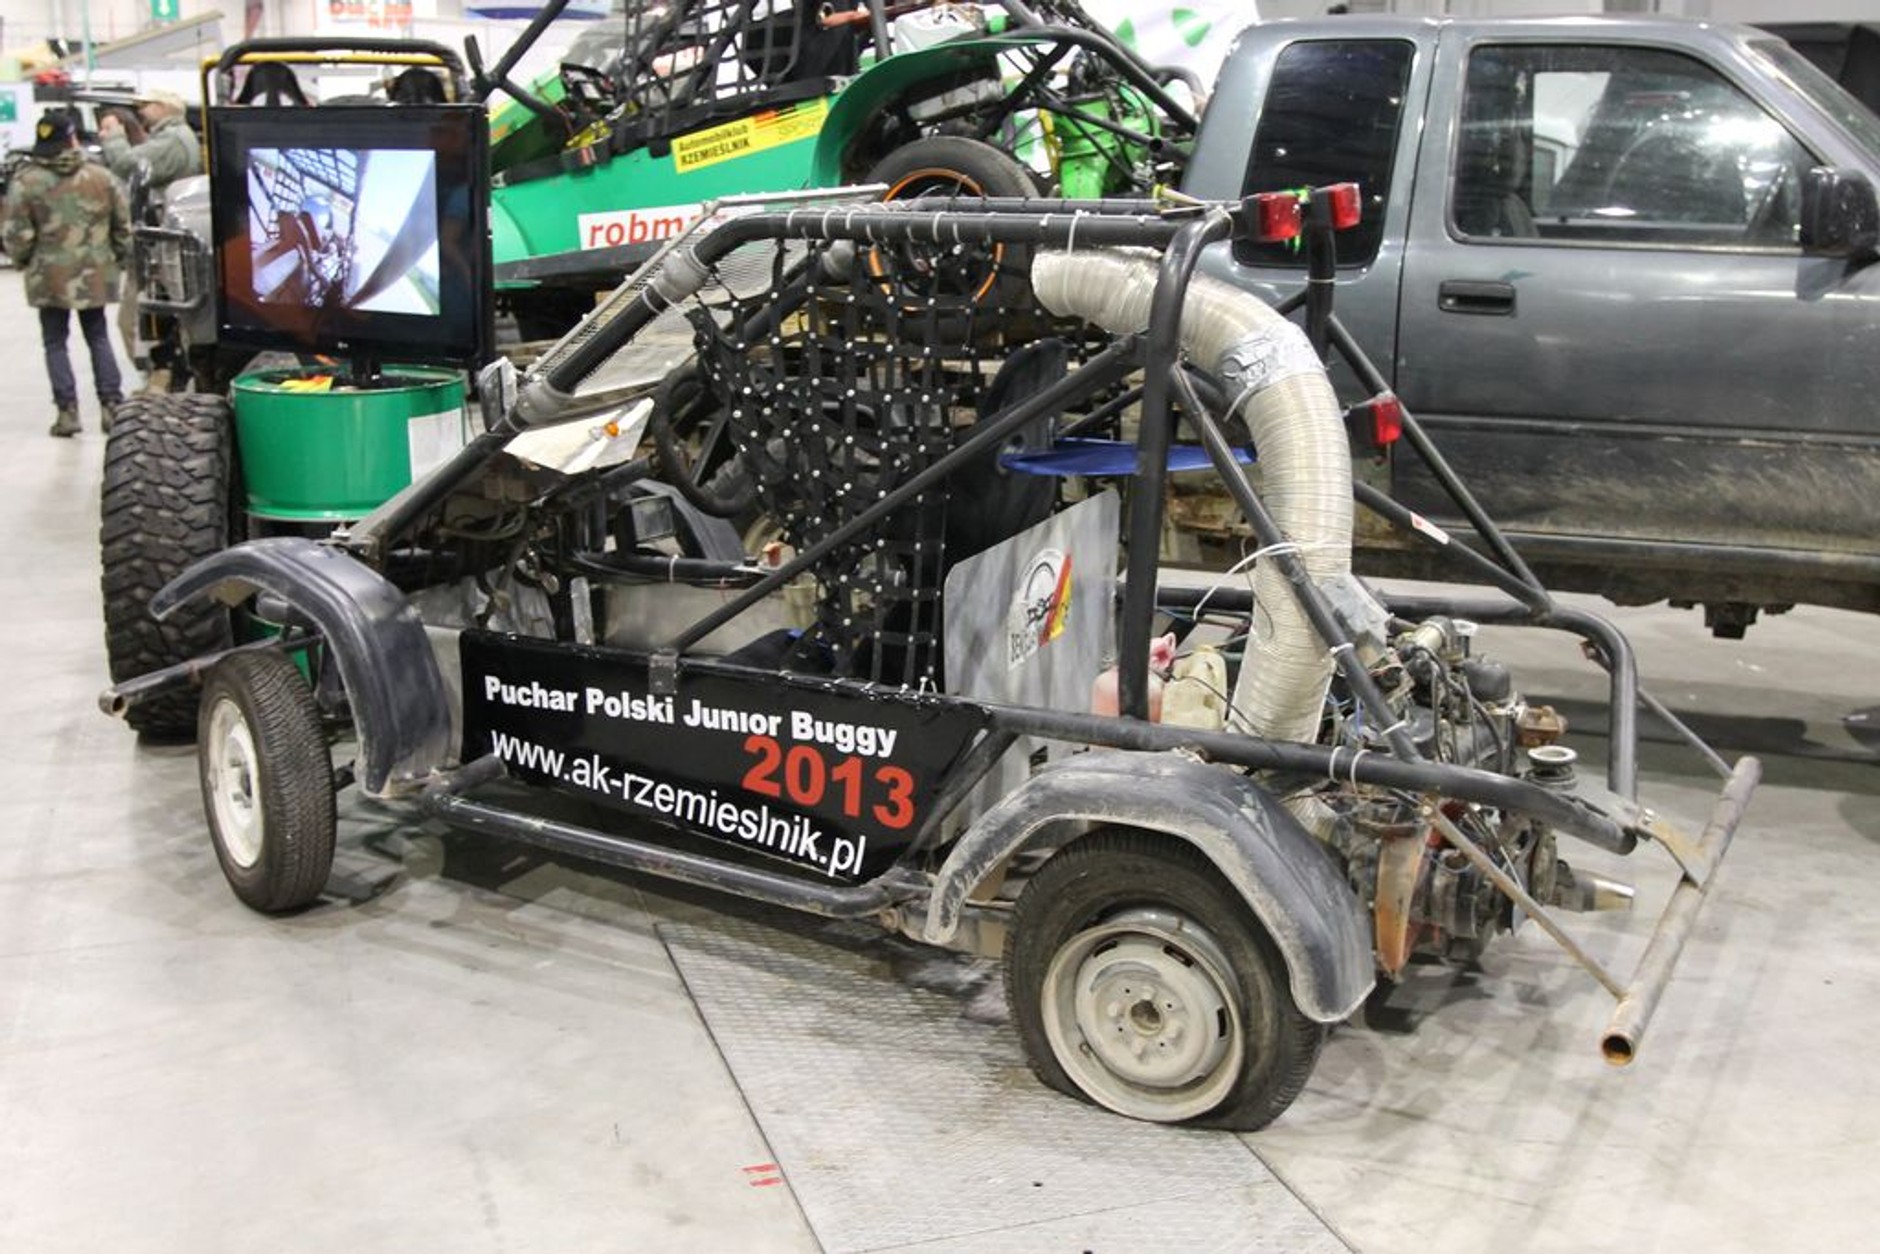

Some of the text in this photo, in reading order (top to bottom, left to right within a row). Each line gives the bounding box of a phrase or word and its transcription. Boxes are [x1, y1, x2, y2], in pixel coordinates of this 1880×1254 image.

[484, 675, 578, 712] Puchar
[585, 687, 675, 724] Polski
[791, 711, 897, 758] Buggy
[491, 730, 866, 877] www.ak-rzemieslnik.pl
[742, 735, 914, 829] 2013
